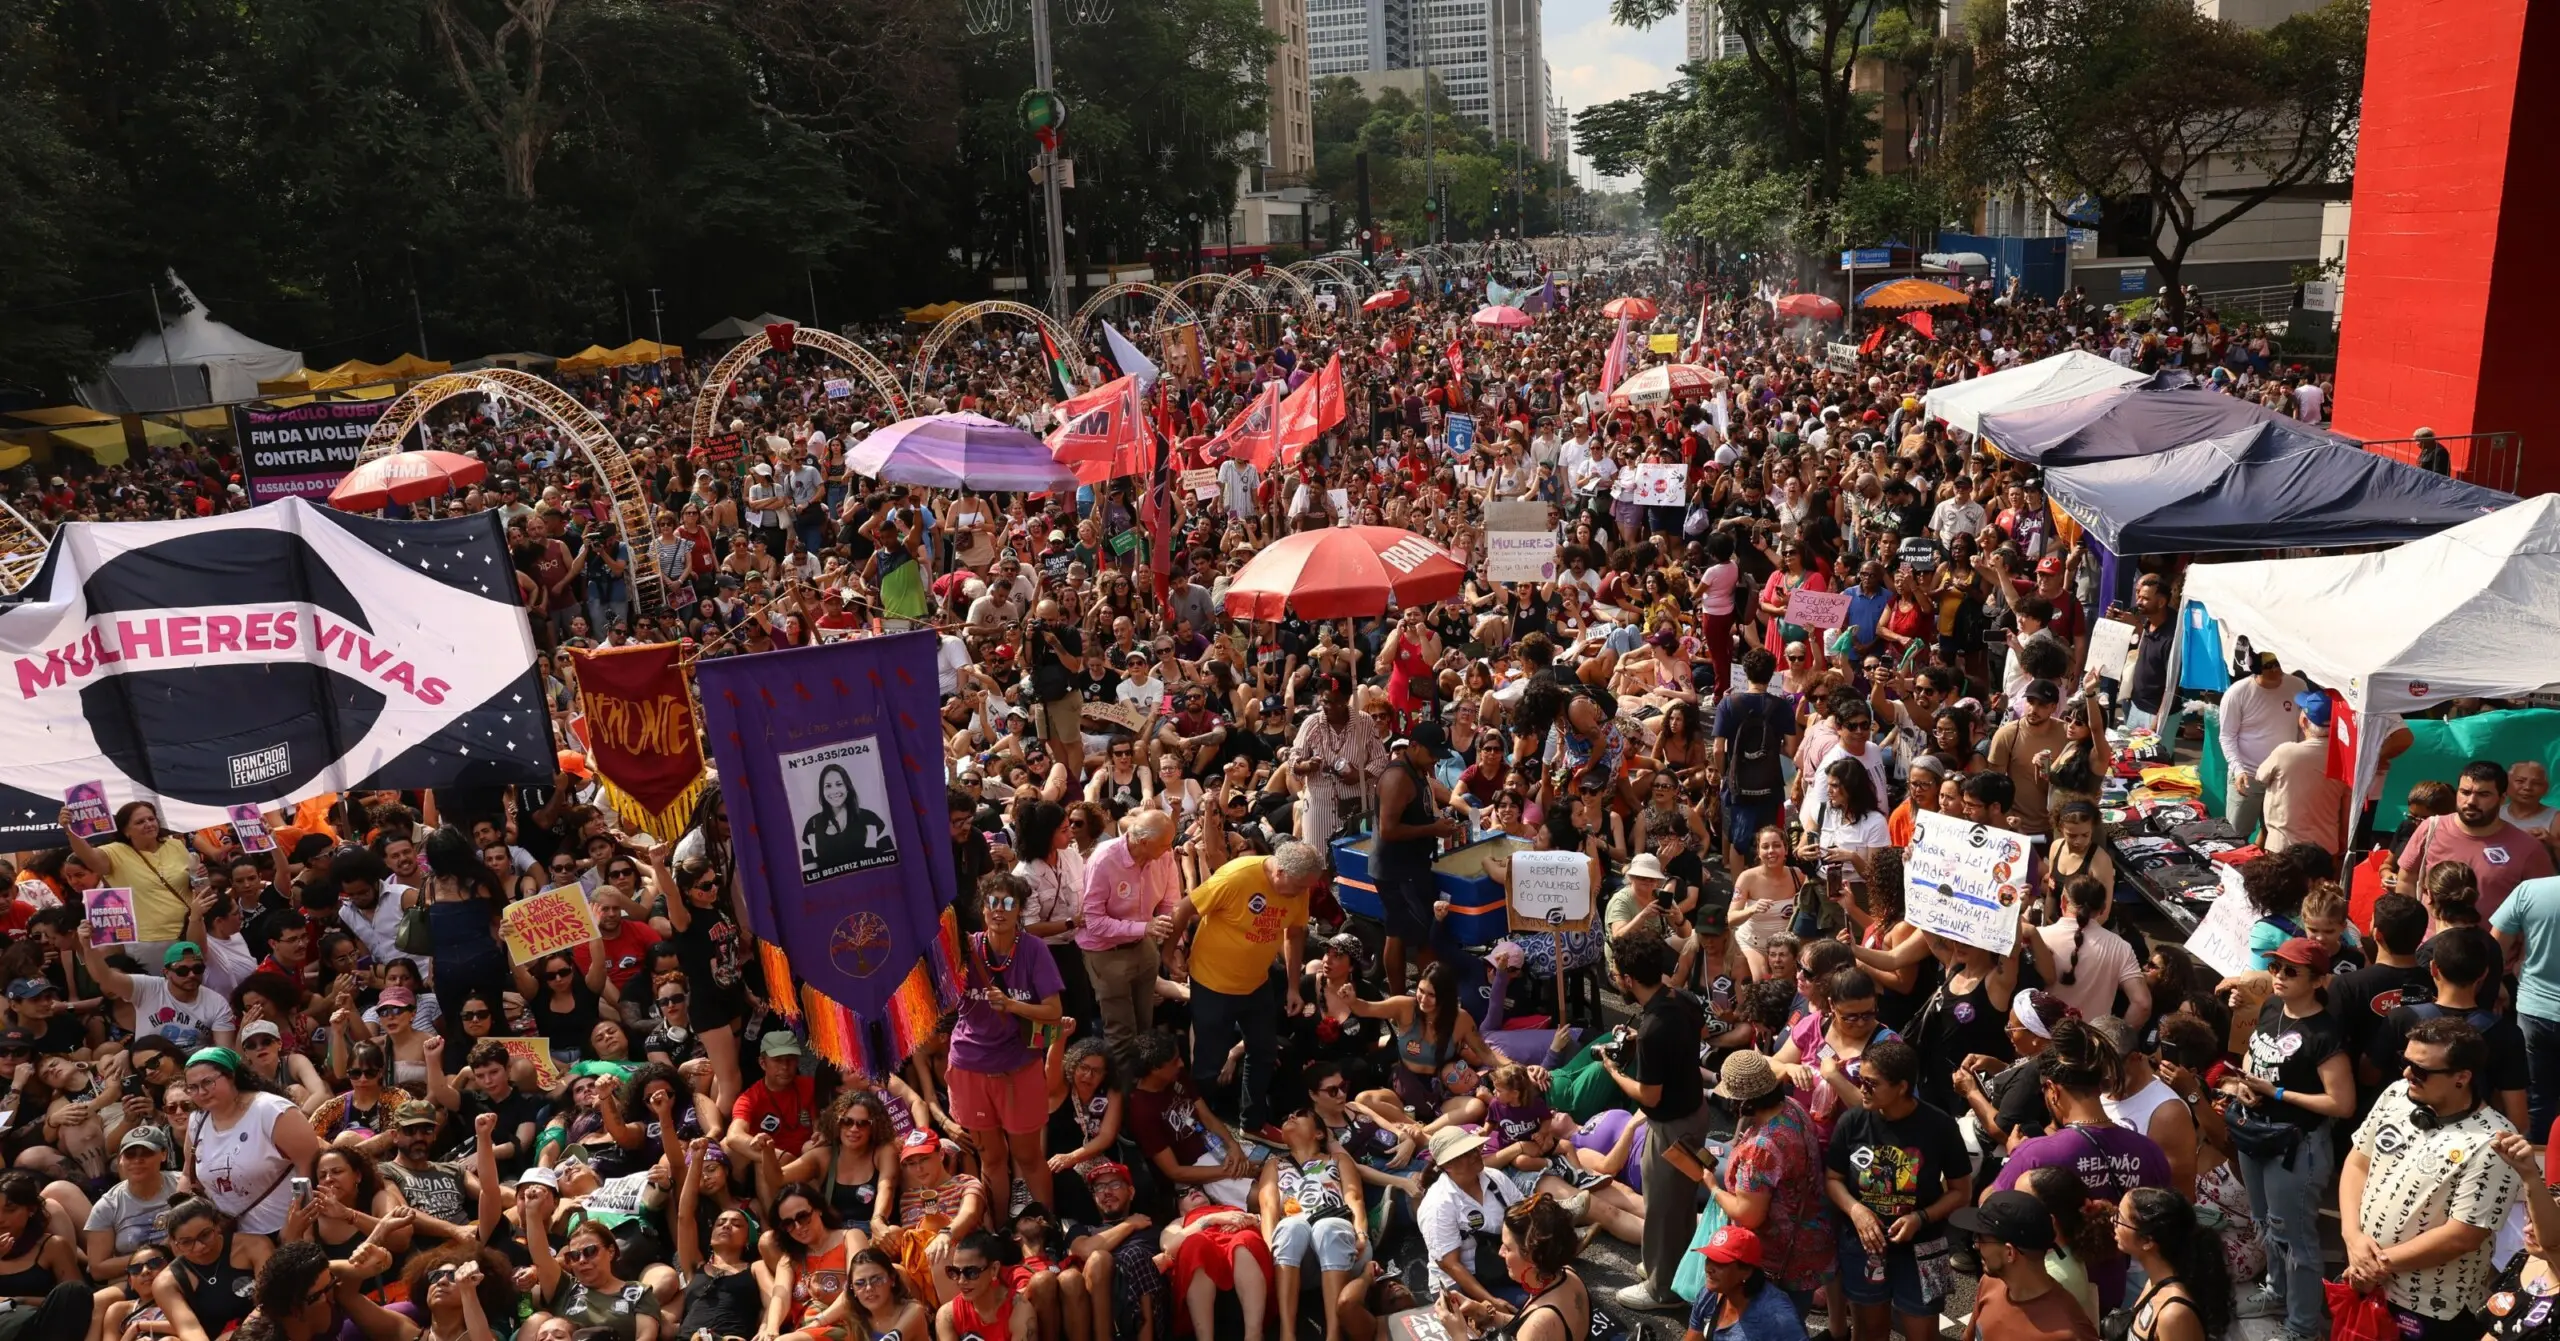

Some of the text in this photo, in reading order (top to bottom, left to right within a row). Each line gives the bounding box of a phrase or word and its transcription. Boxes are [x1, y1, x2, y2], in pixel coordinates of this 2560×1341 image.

[1637, 391, 1662, 401] AMSTEL
[1679, 387, 1704, 396] AMSTEL
[278, 406, 328, 423] PAULO
[332, 404, 378, 419] QUER
[251, 429, 276, 445] FIM
[279, 429, 302, 444] DA
[254, 449, 325, 467] CONTRA
[256, 479, 305, 494] CASSAÇÃO
[307, 479, 324, 491] DO
[1491, 537, 1554, 549] MULHERES
[14, 611, 452, 706] MULHERES VIVAS
[232, 746, 287, 772] BANCADA
[234, 762, 288, 785] FEMINISTA
[0, 822, 65, 833] EMINISTA
[806, 854, 896, 882] LEI BEATRIZ MILANO
[1530, 866, 1578, 876] RESPEITAR
[1519, 880, 1580, 890] AS MULHERES
[509, 894, 564, 922] UM BRASIL
[513, 902, 576, 932] DE MULHERES
[92, 916, 130, 929] MATA.
[520, 914, 584, 945] VIVAS
[529, 928, 591, 956] E LIVRES
